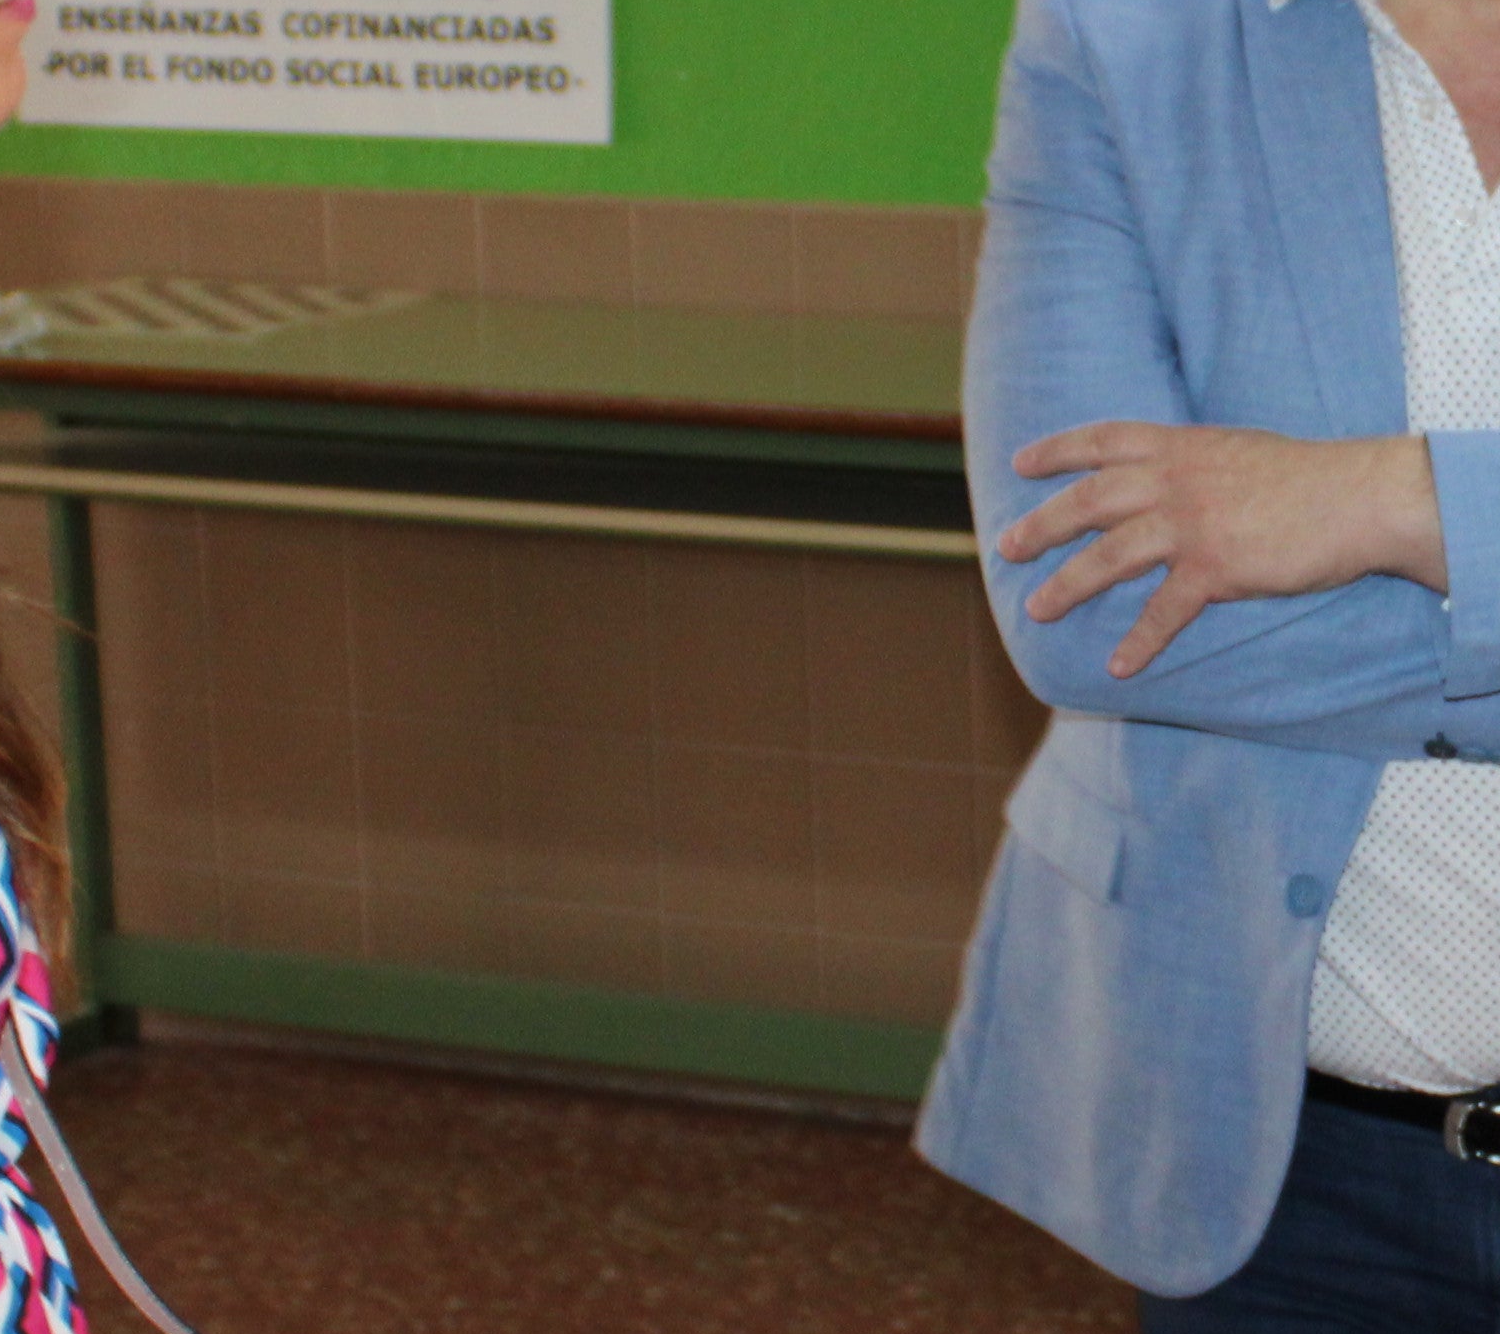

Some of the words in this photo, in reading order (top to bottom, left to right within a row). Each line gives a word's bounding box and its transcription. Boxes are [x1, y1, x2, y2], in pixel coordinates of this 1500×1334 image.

[58, 0, 262, 38] ENSEÑANZAS
[282, 12, 557, 45] COFINANCIADAS
[48, 50, 112, 80] POR
[122, 52, 158, 82] EL
[166, 54, 277, 85] FONDO
[285, 58, 403, 89] SOCIAL
[412, 62, 571, 94] EUROPEO
